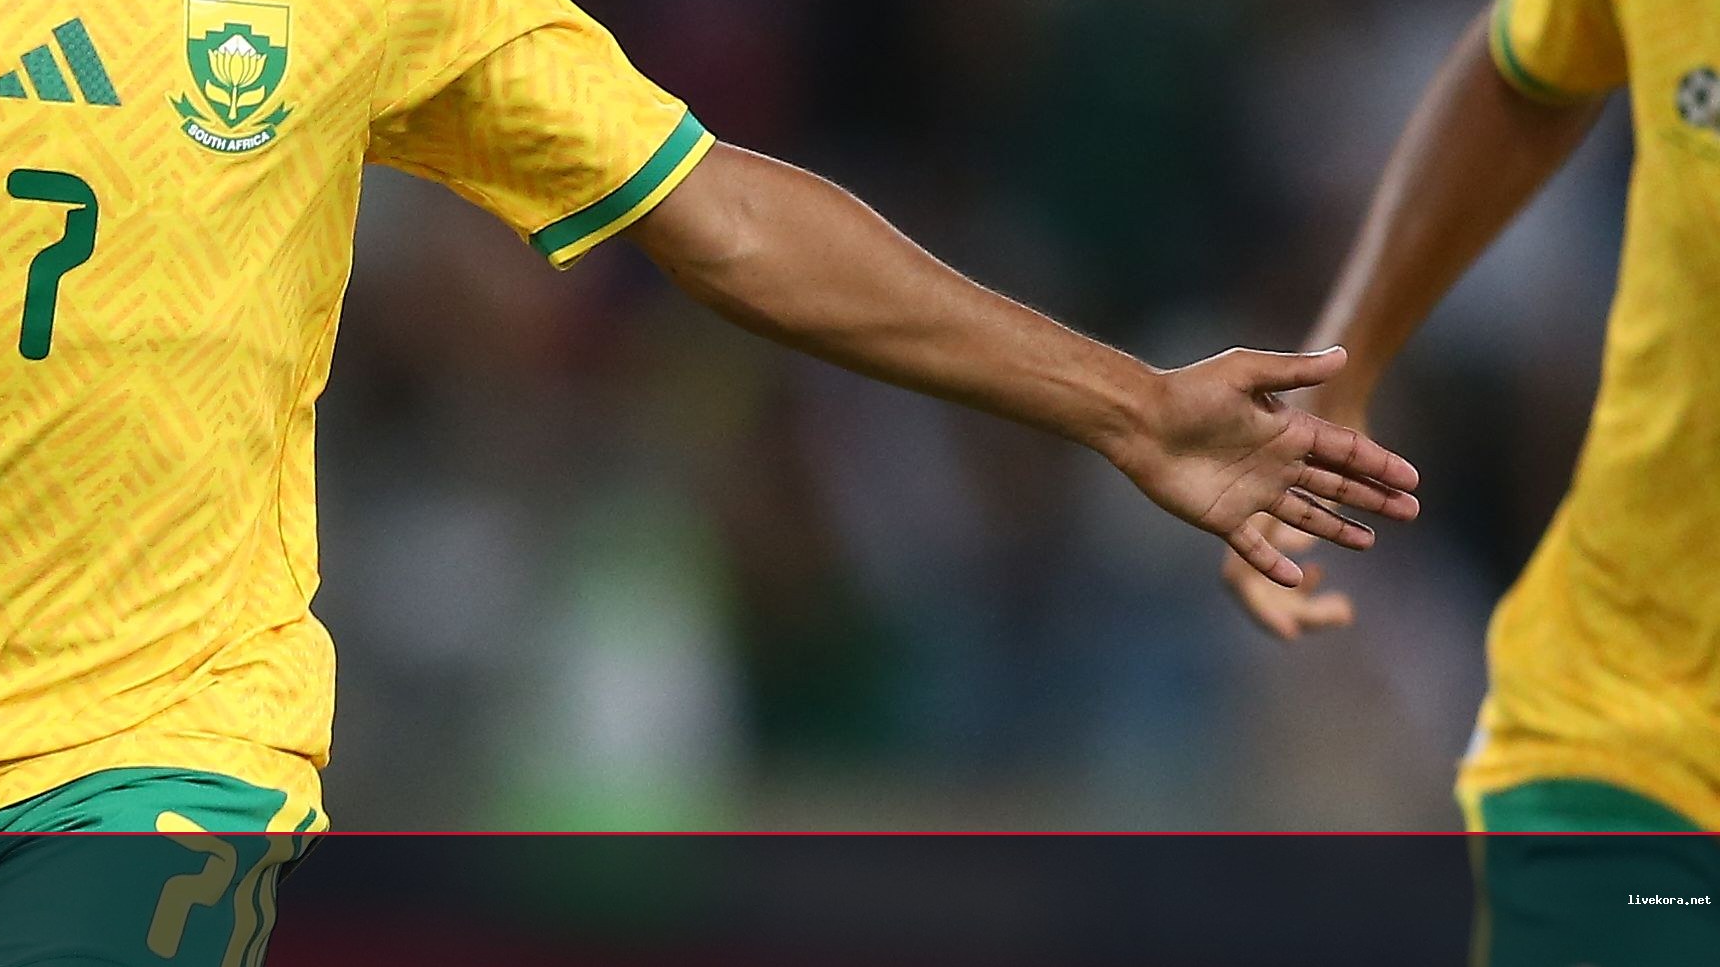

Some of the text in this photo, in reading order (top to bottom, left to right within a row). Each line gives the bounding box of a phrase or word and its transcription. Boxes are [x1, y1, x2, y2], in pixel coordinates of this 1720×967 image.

[188, 124, 270, 151] SOUTH AFRICA
[7, 168, 99, 361] 7
[146, 810, 238, 959] 7
